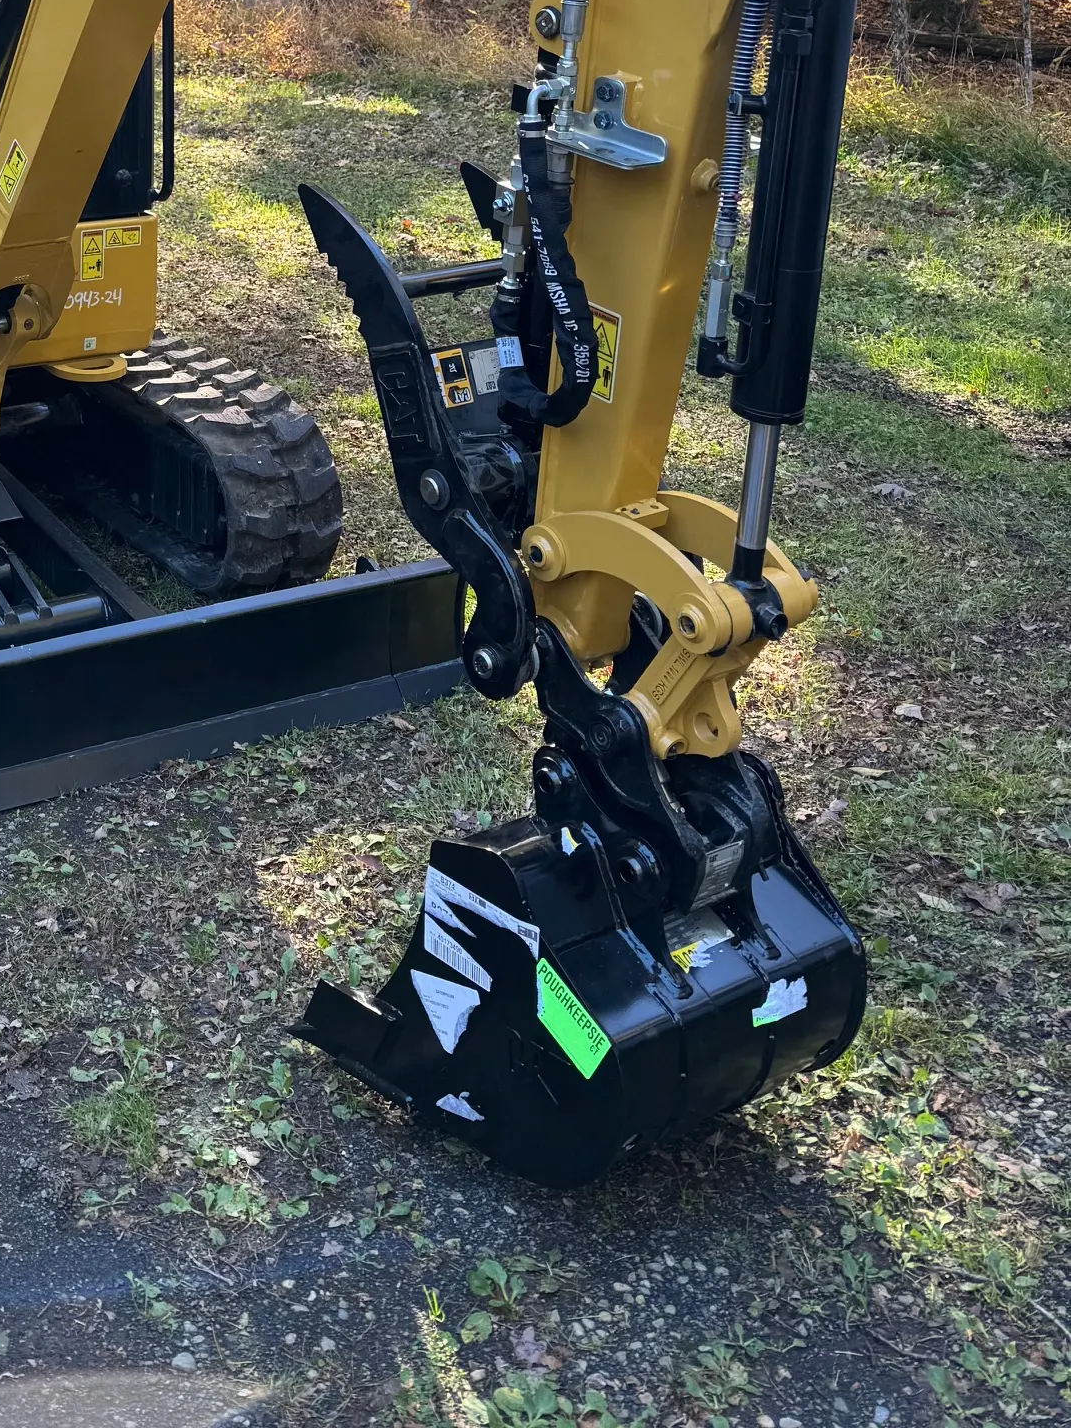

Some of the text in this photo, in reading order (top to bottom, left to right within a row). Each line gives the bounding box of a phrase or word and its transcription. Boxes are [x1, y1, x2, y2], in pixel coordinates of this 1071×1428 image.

[530, 217, 558, 276] 541-7089
[545, 281, 571, 315] MSHA
[573, 343, 591, 383] 359/01
[453, 387, 471, 403] CAT
[652, 679, 669, 700] KGS
[537, 963, 606, 1049] POUGHKEEPSIE
